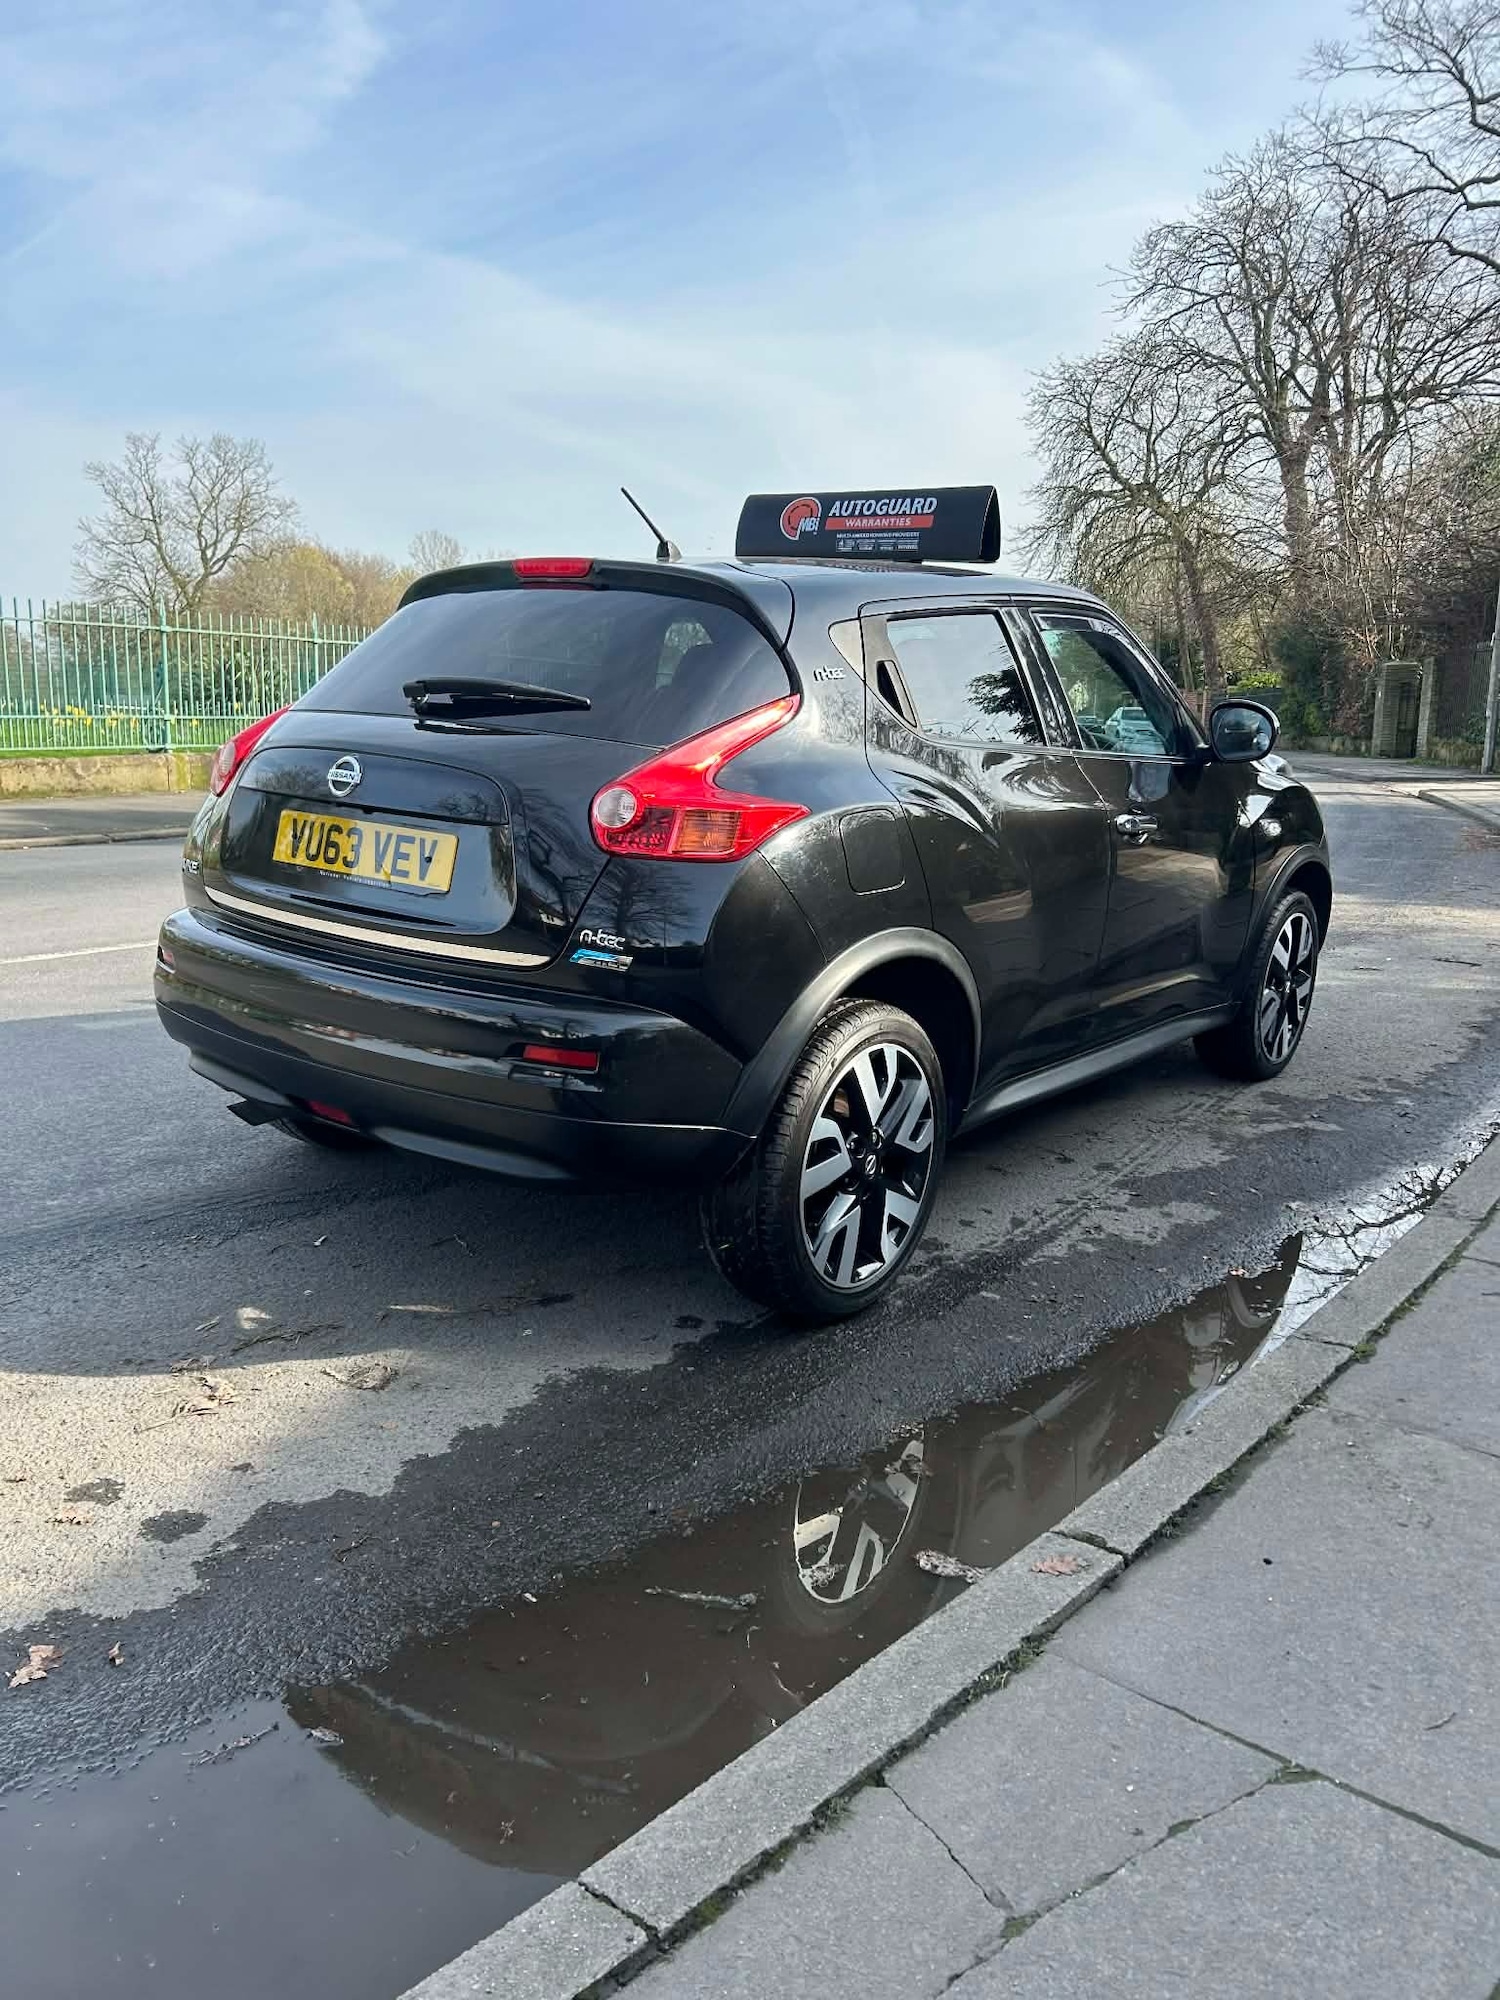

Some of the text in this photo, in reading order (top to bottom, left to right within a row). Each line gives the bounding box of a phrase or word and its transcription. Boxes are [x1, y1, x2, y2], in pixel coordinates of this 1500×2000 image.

[828, 497, 937, 517] AUTOGUARD
[845, 516, 911, 528] WARRANTIES
[290, 817, 438, 881] VU63 VEV
